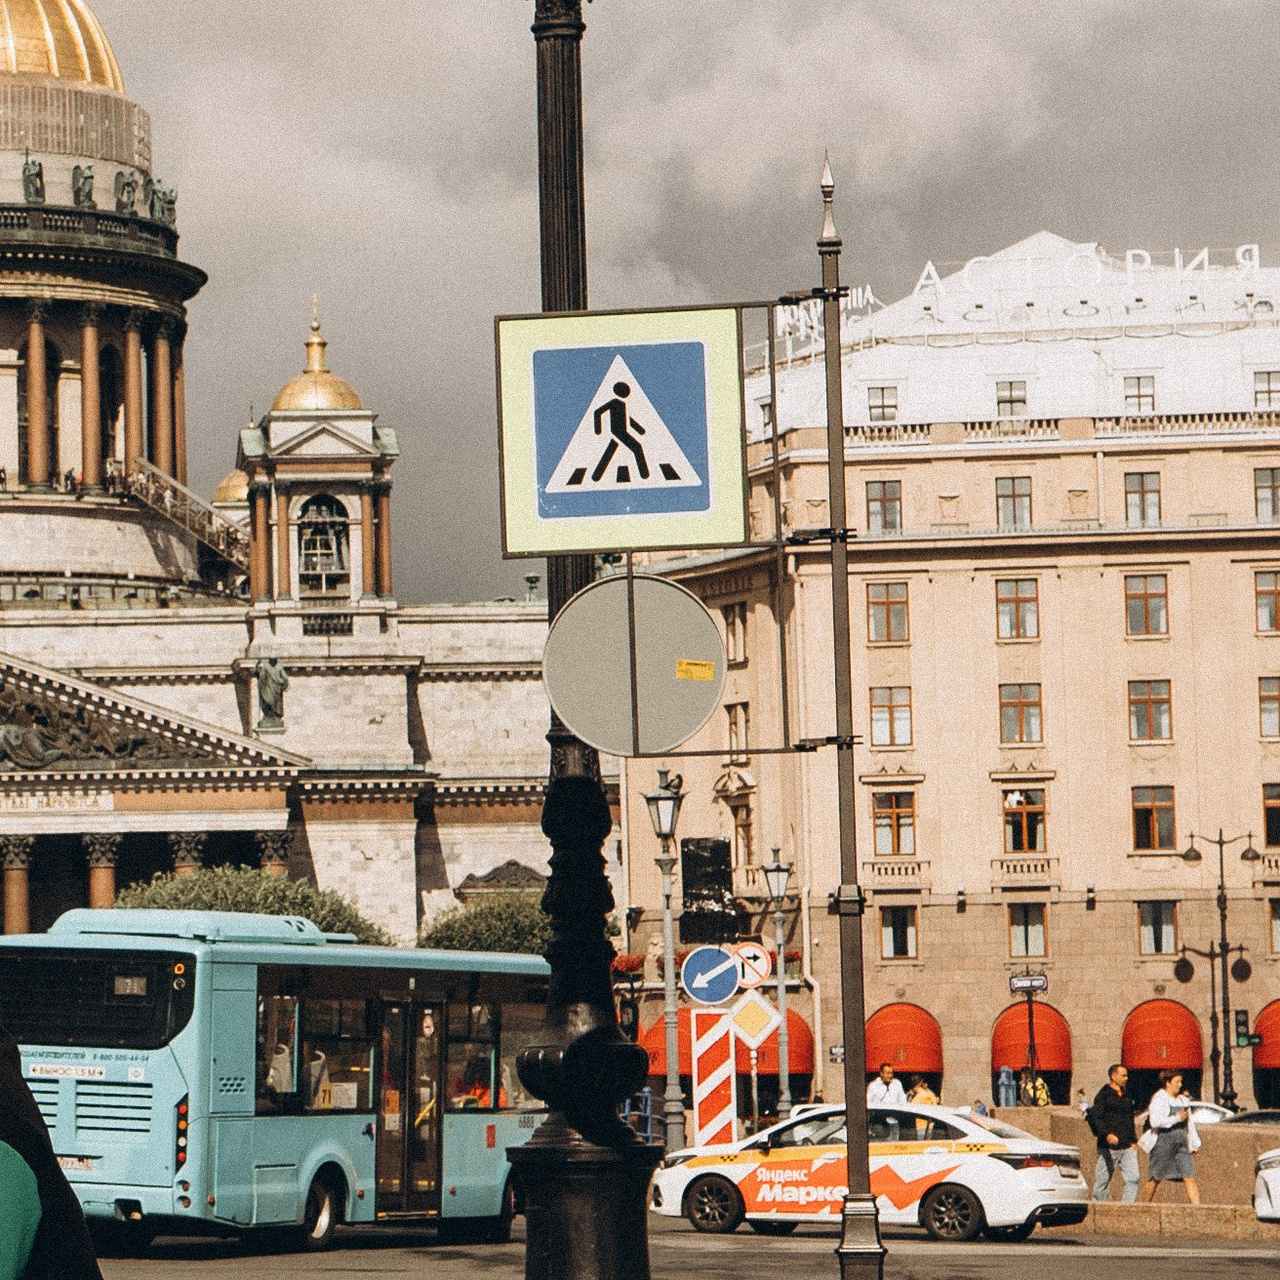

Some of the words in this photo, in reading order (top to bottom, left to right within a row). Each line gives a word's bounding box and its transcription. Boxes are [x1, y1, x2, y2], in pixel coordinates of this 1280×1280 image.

[322, 1089, 331, 1104] 71
[756, 1168, 808, 1183] Яндекс
[756, 1183, 849, 1205] Марке
